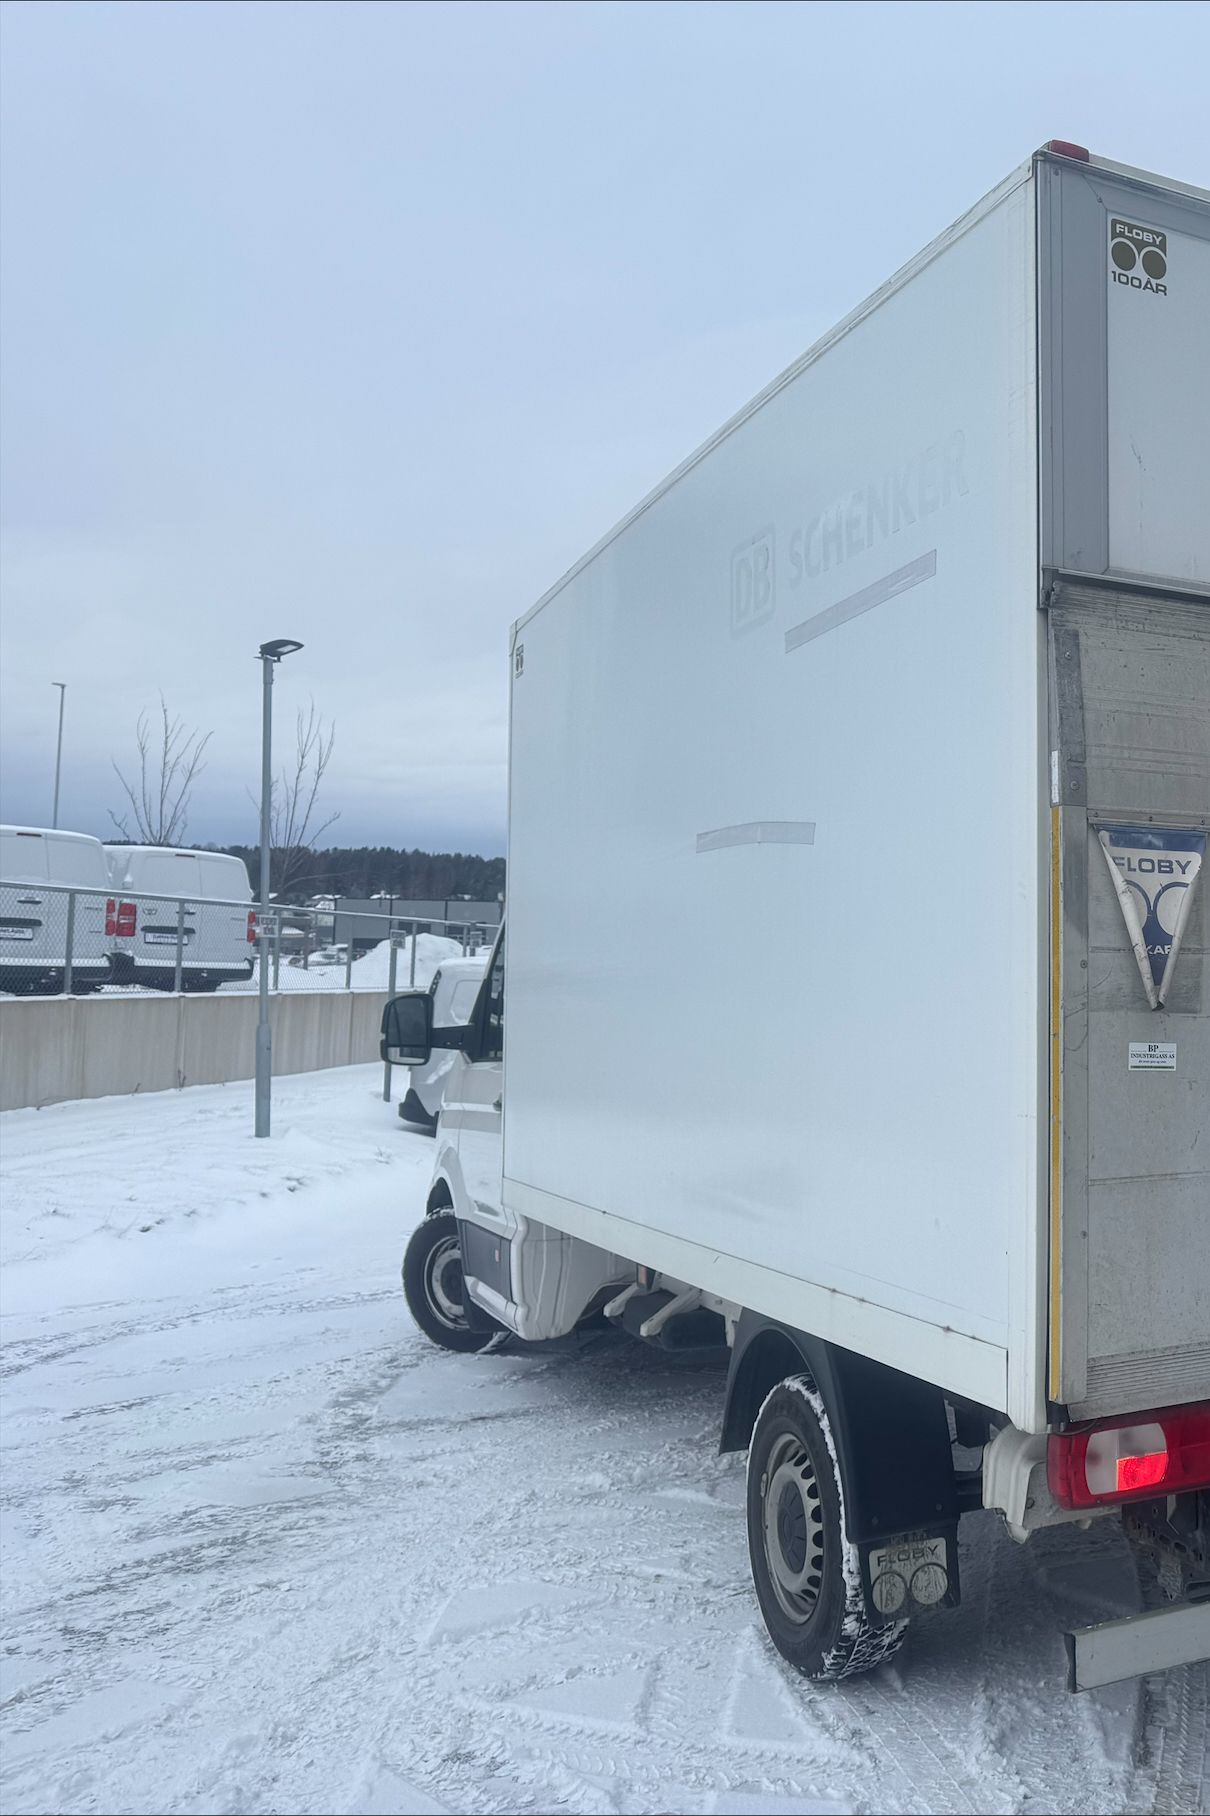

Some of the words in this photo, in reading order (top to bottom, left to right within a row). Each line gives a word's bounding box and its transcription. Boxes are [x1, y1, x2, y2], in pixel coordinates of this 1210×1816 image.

[1115, 223, 1163, 245] FLOBY
[1112, 855, 1192, 875] FLOBY
[1147, 1044, 1159, 1053] BP
[877, 1544, 939, 1568] FLOBY
